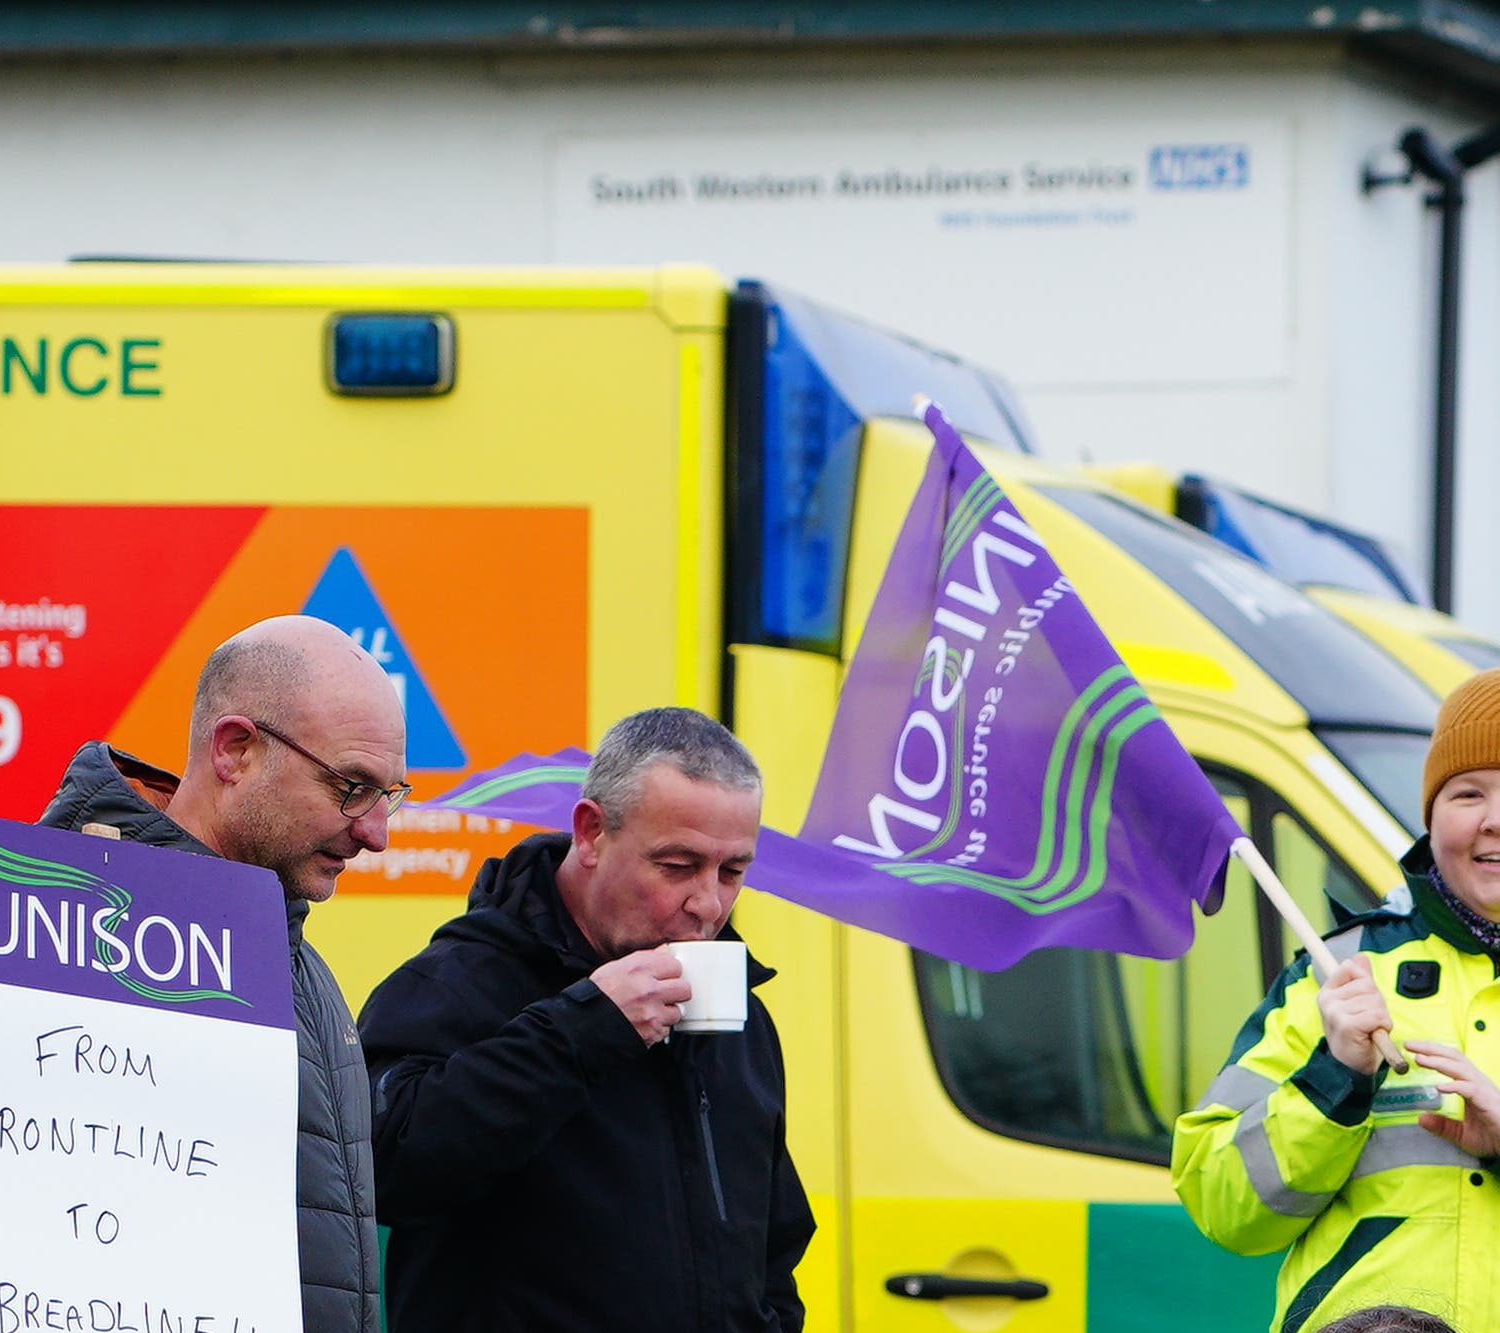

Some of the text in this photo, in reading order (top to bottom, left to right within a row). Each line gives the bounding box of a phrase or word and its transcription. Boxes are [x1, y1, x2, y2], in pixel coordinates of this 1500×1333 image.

[15, 632, 64, 669] it's
[35, 1025, 157, 1086] FROM
[66, 1203, 119, 1244] TO
